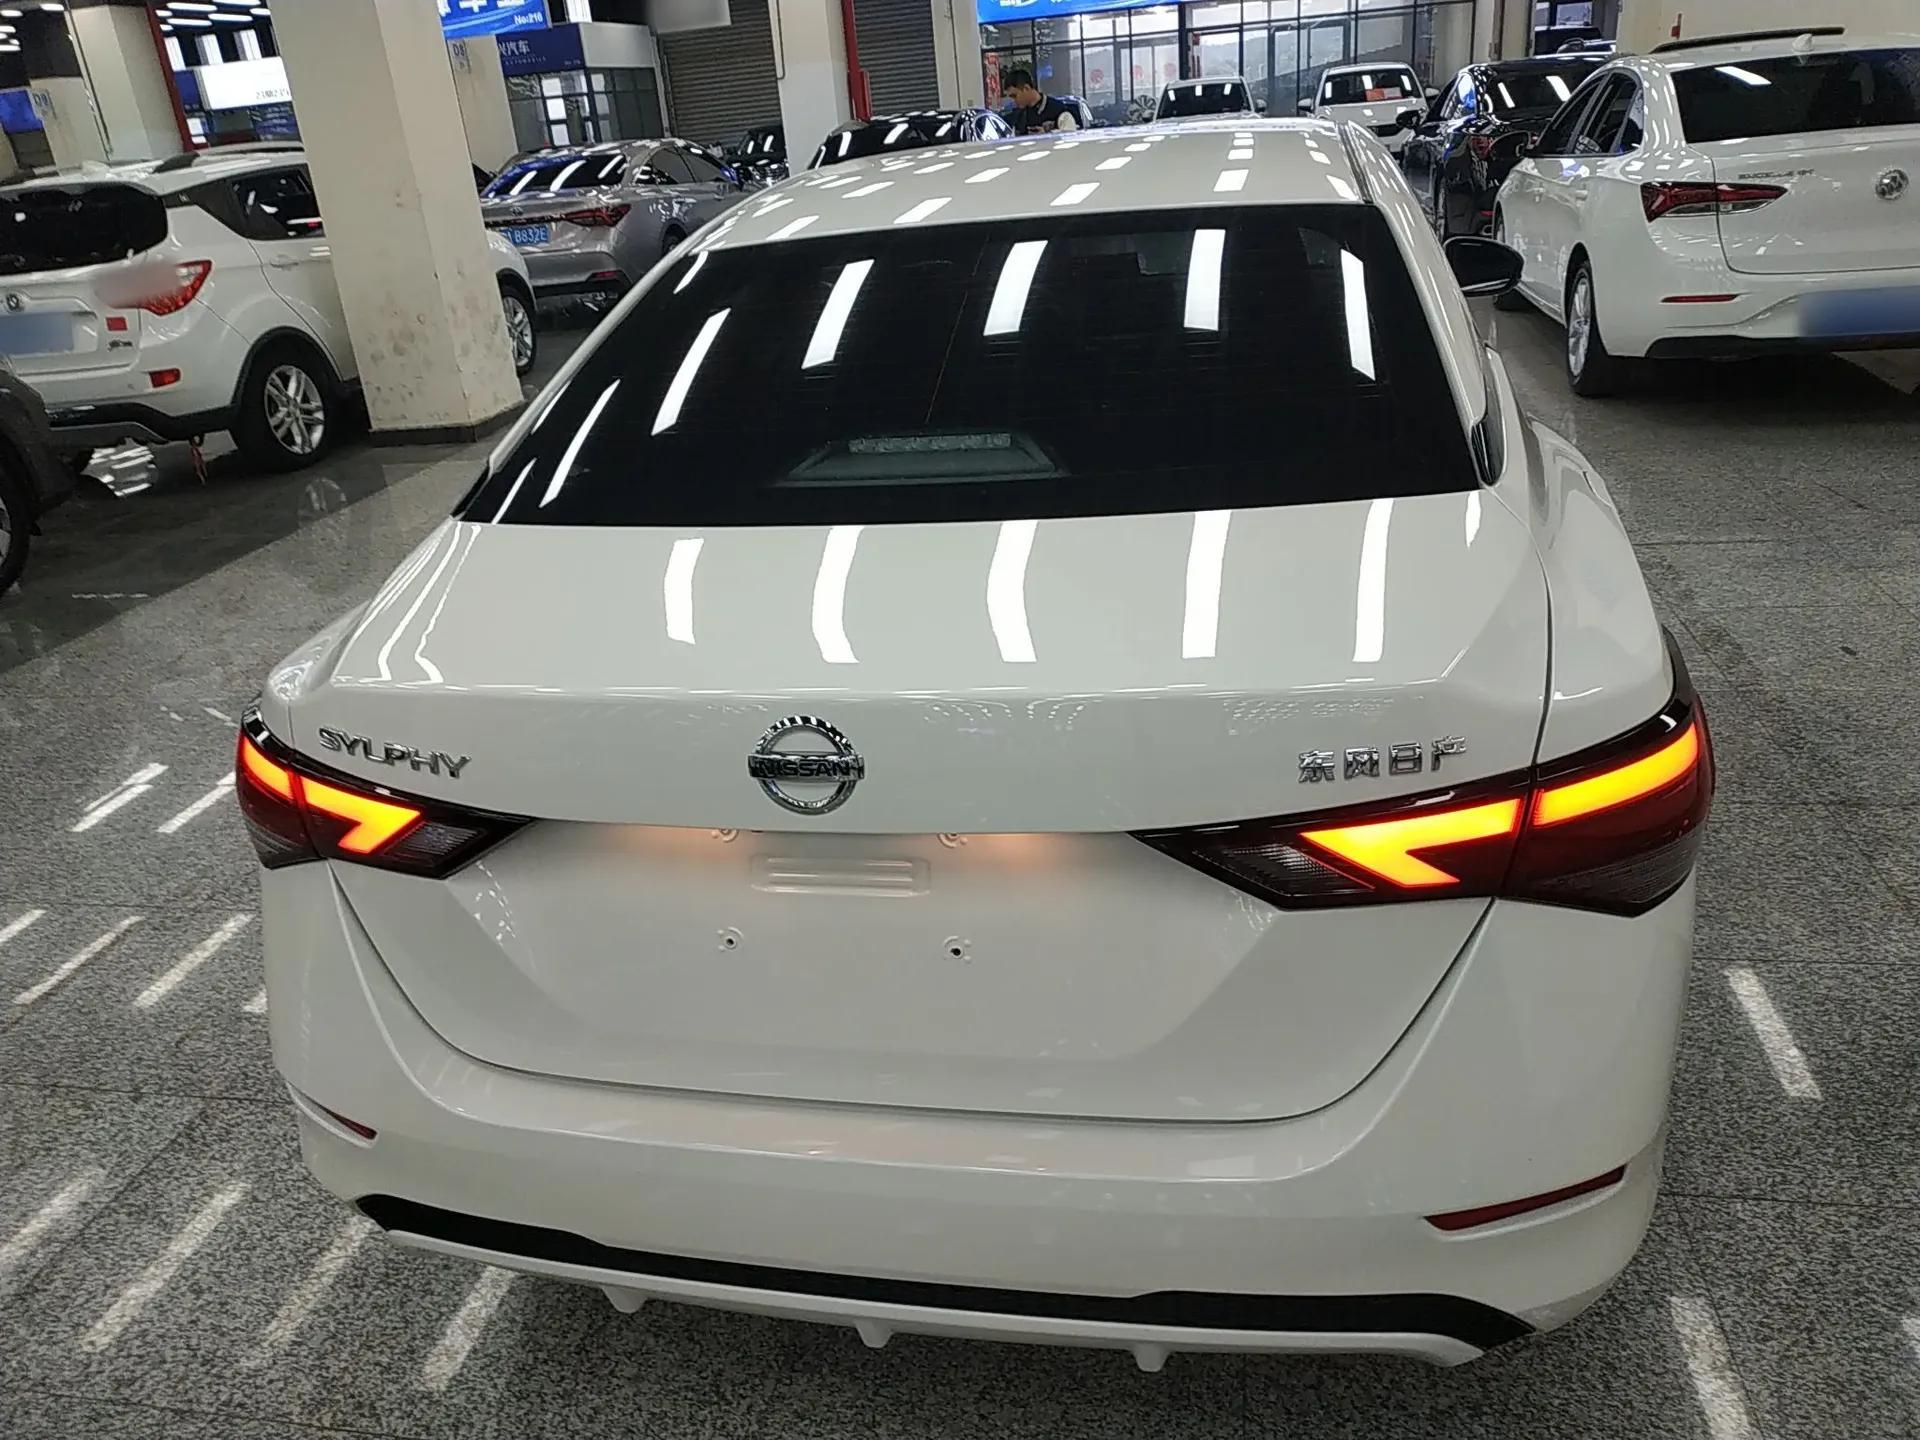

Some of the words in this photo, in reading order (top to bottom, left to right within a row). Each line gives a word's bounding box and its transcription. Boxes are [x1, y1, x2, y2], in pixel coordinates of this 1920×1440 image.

[318, 726, 472, 779] SYLPHY
[758, 757, 852, 778] NISSAN
[1298, 735, 1467, 784] 东风日产
